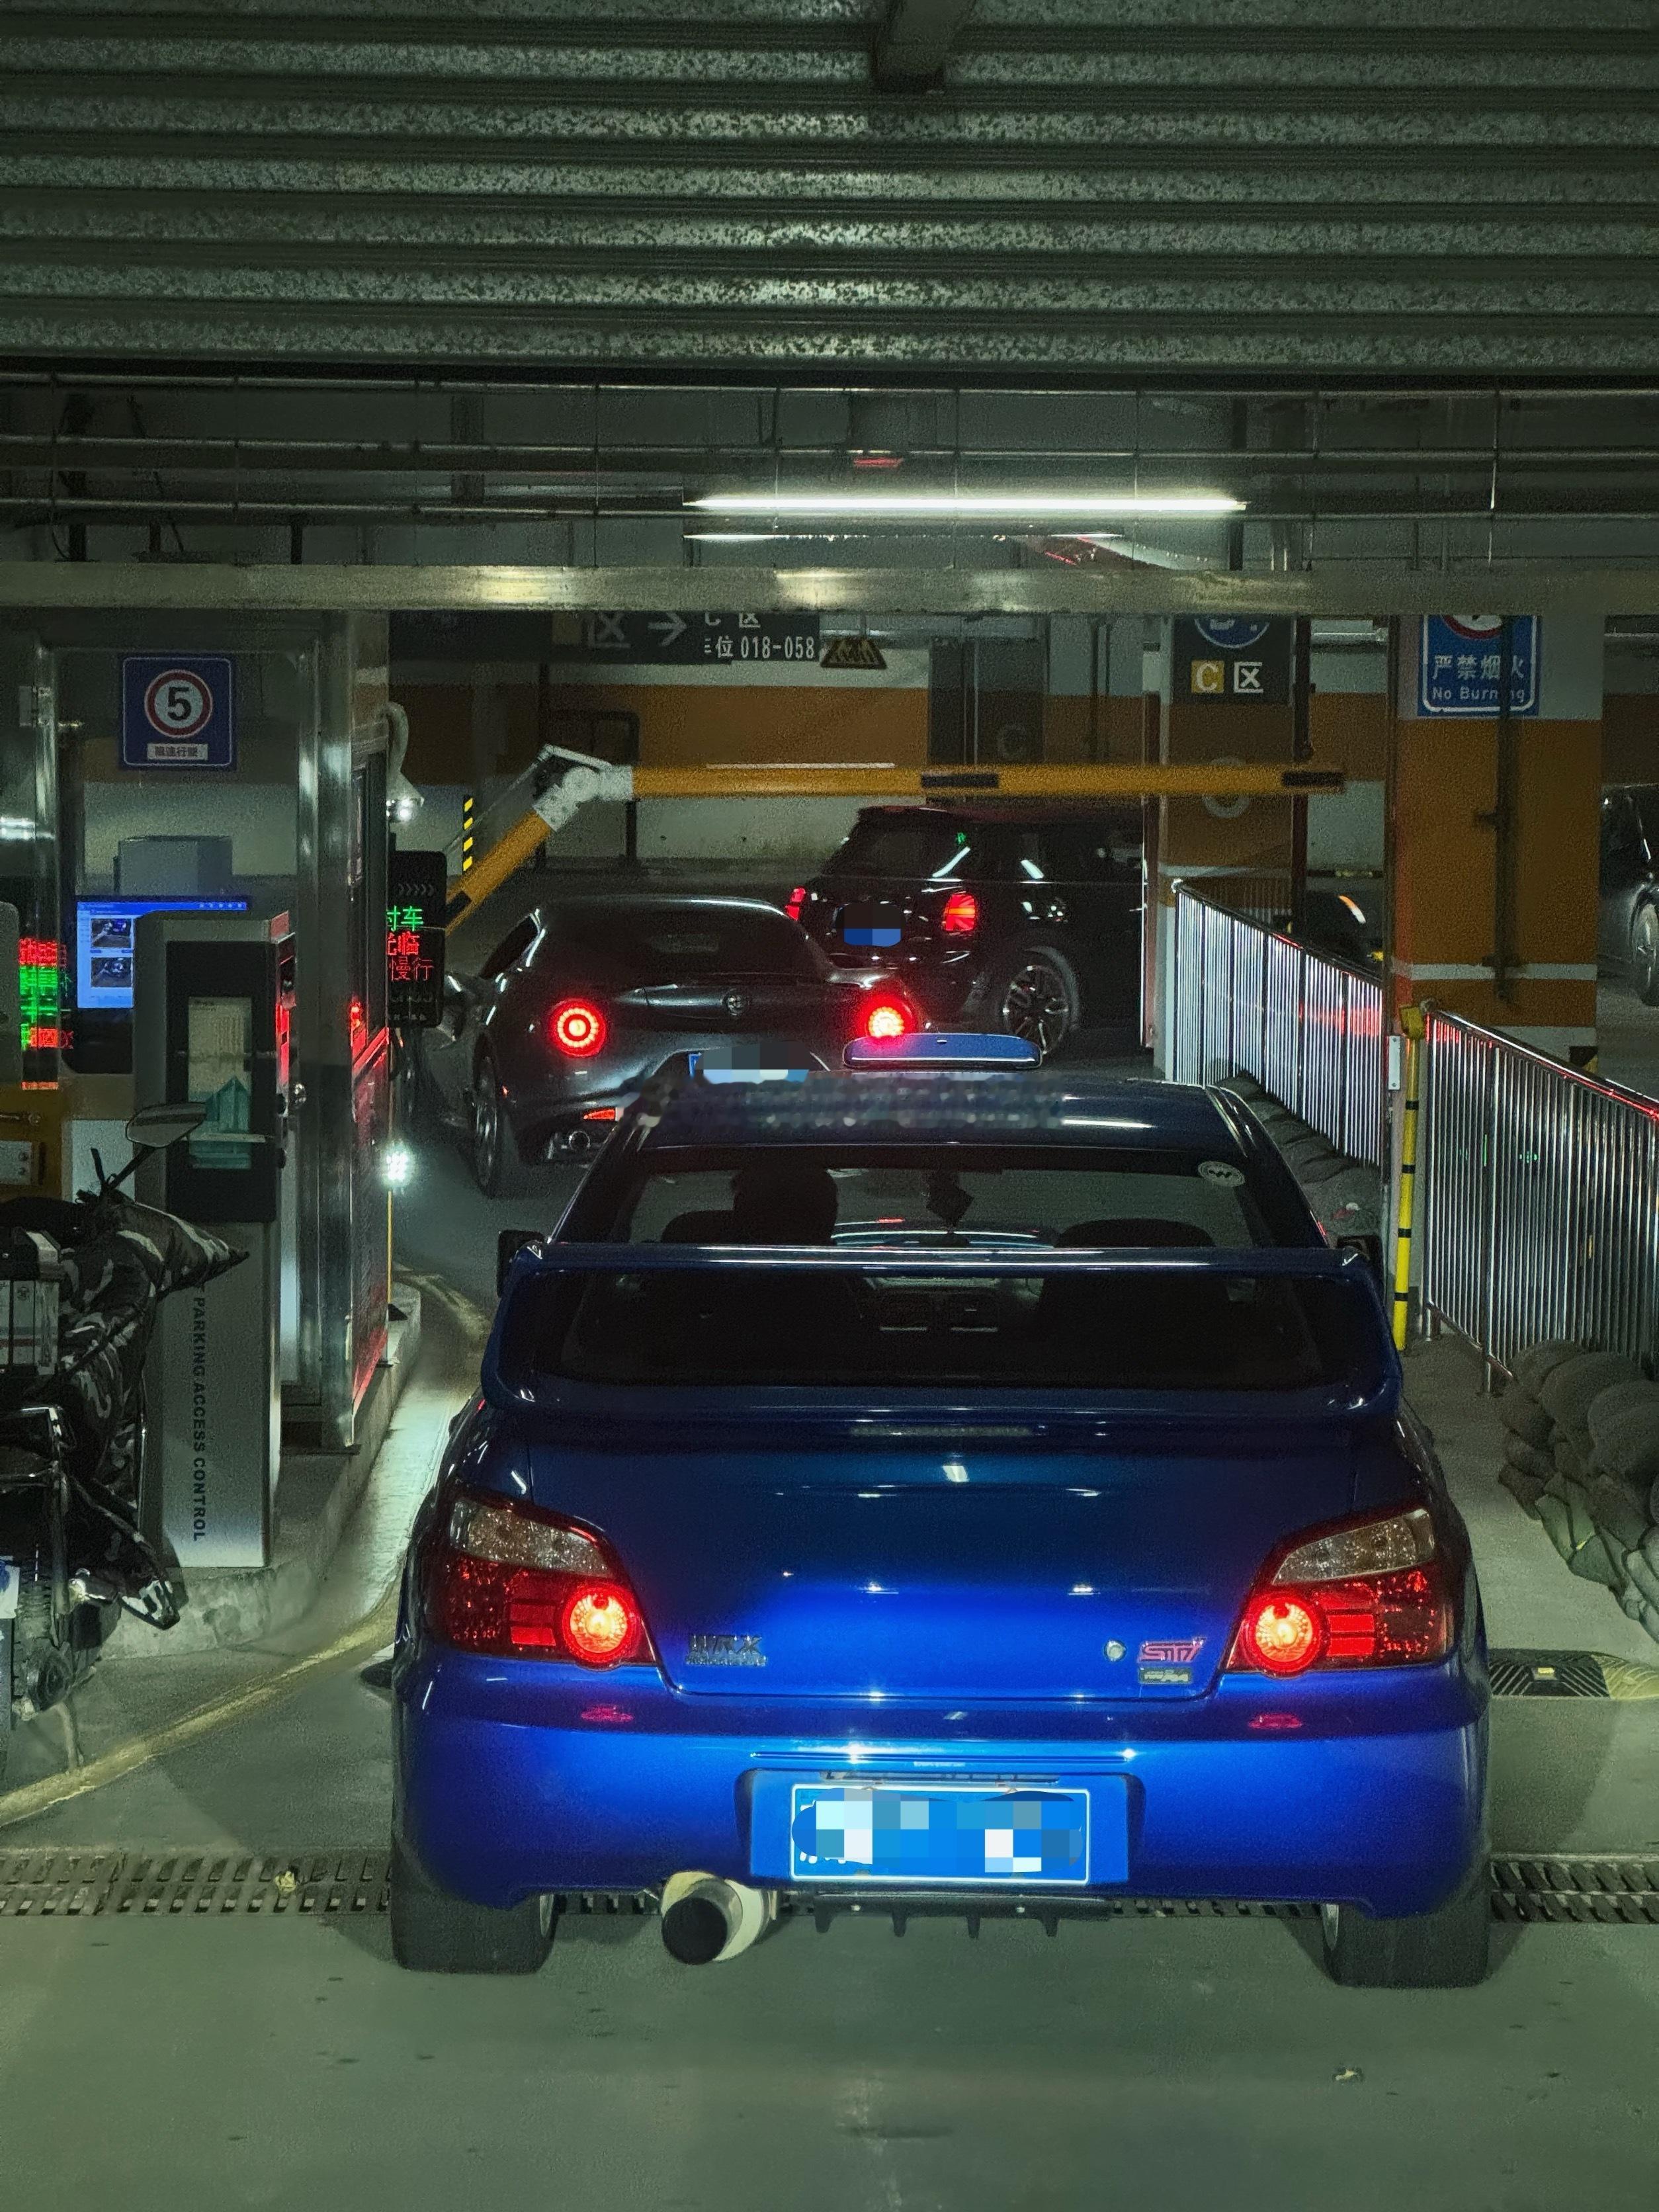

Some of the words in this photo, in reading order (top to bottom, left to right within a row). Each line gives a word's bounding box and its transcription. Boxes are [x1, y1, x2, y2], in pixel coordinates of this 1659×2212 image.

[740, 636, 815, 659] 018-058
[1195, 662, 1218, 691] C
[1233, 661, 1264, 693] 区
[1431, 654, 1525, 680] 严禁烟火
[167, 686, 192, 721] 5
[1432, 686, 1452, 700] No
[1459, 686, 1525, 702] Burng
[389, 956, 434, 982] 慢行
[193, 1297, 206, 1377] PARKING
[193, 1382, 206, 1452] ACCESS
[193, 1457, 206, 1542] CONTROL
[1137, 1637, 1206, 1663] STI
